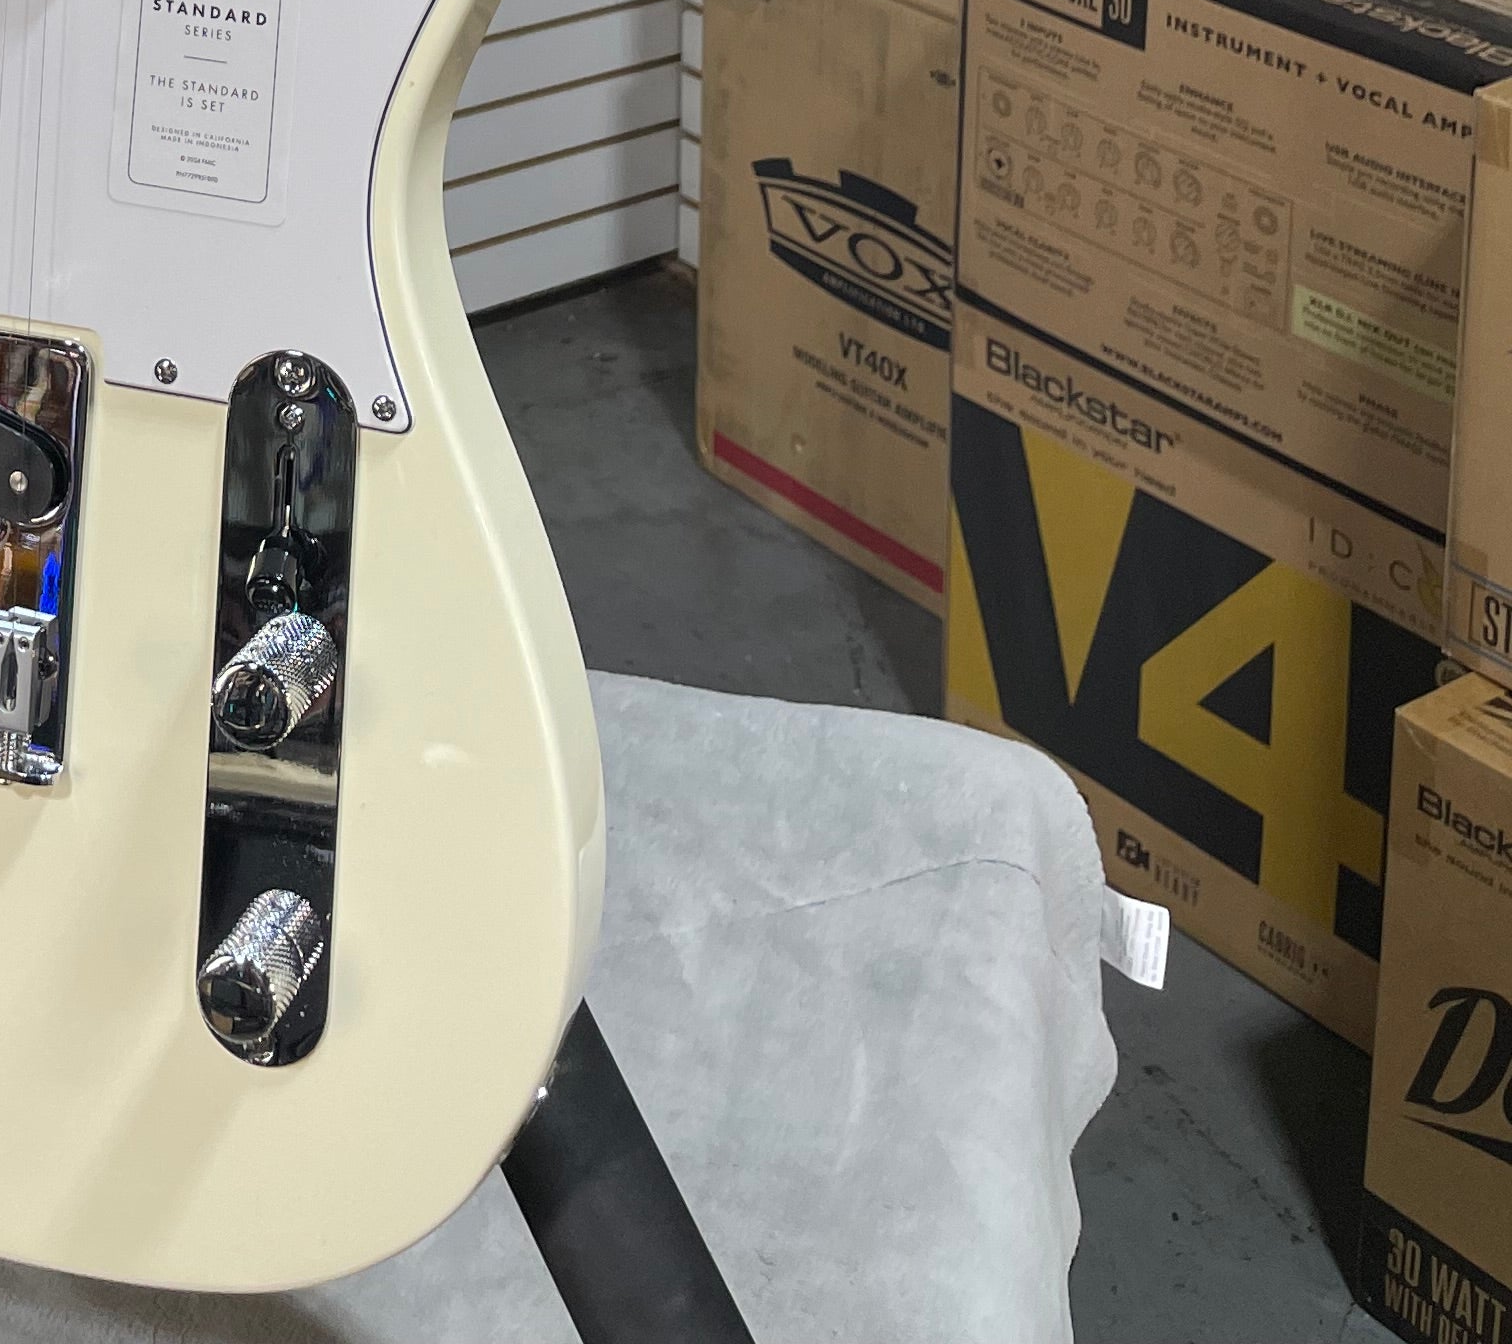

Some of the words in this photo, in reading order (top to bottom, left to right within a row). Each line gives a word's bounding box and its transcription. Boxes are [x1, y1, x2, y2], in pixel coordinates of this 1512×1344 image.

[183, 24, 233, 42] SERIES
[149, 74, 175, 89] THE
[181, 79, 260, 102] STANDARD
[1165, 14, 1308, 79] INSTRUMENT
[1335, 76, 1414, 120] VOCAL
[1422, 110, 1474, 140] AMP
[180, 95, 194, 109] IS
[200, 99, 226, 113] SET
[195, 139, 240, 153] INDONESIA
[203, 132, 251, 146] CALIFORNIA
[780, 195, 952, 311] VOX
[838, 331, 909, 392] VT40X
[987, 335, 1175, 454] Blackstar
[1386, 1227, 1422, 1288] 30
[1430, 1254, 1508, 1344] WATT
